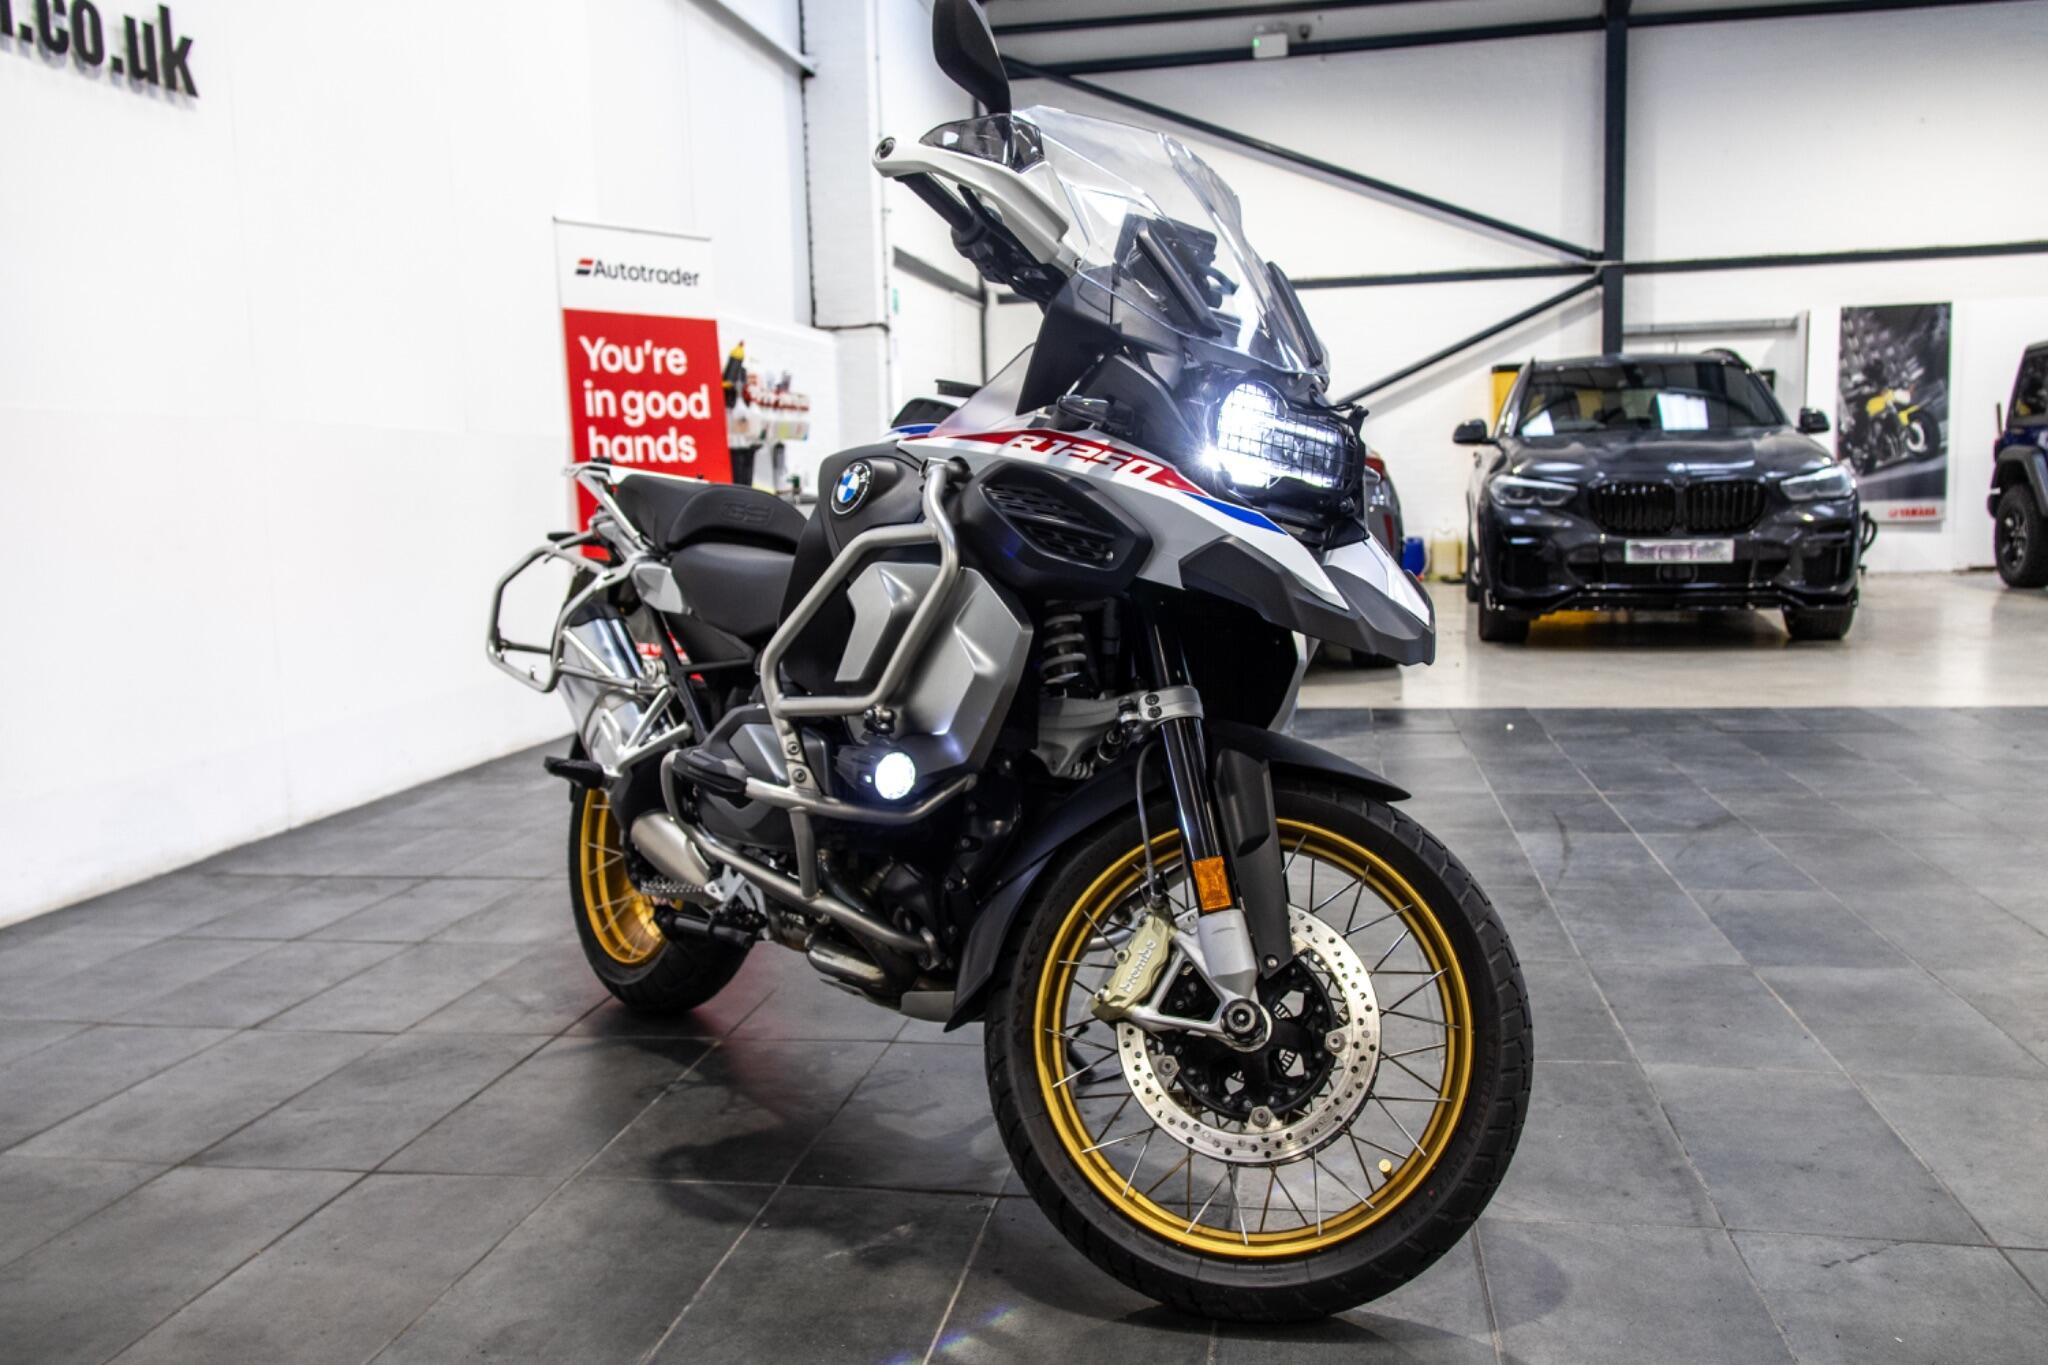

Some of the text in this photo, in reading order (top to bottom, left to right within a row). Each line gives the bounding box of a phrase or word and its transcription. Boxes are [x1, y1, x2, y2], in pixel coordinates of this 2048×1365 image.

[593, 261, 700, 287] Autotrader
[578, 336, 687, 375] You're
[583, 380, 711, 428] in good
[588, 426, 697, 463] hands
[1120, 940, 1156, 993] brembo
